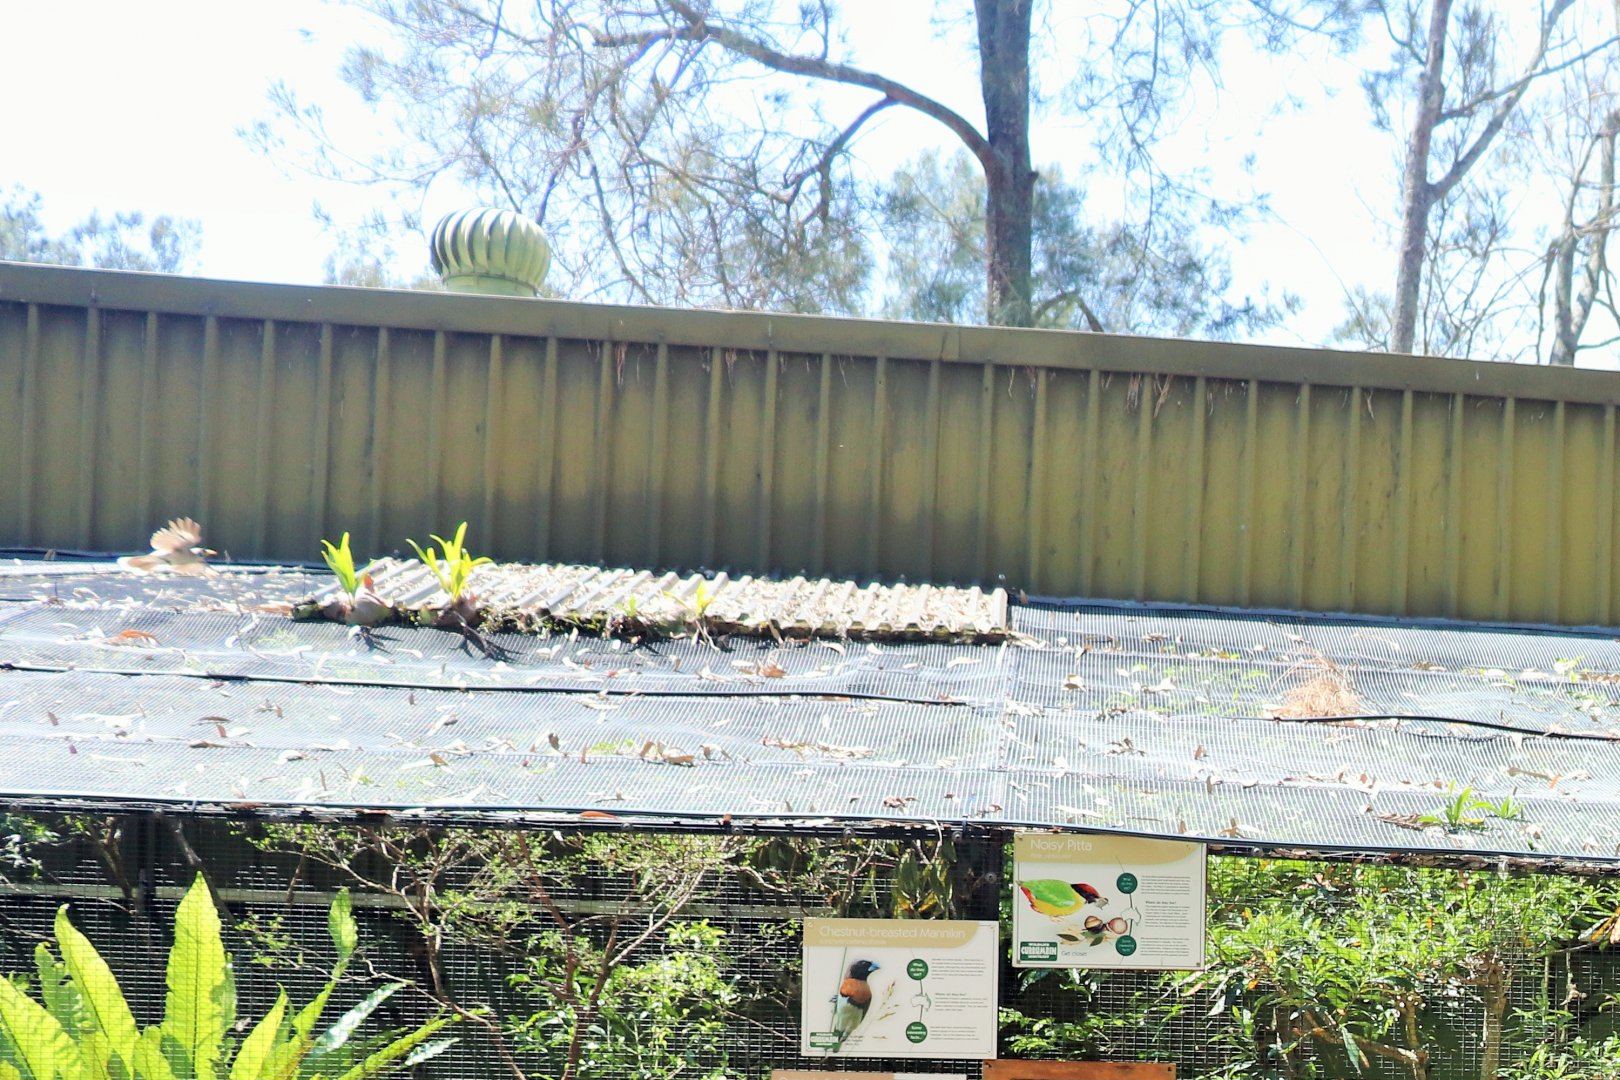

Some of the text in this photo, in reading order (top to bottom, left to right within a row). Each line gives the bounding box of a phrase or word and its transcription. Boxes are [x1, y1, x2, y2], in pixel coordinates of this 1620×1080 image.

[1030, 839, 1093, 854] Noisy Pitta
[819, 926, 966, 938] Chestnut-breasted Mannikin
